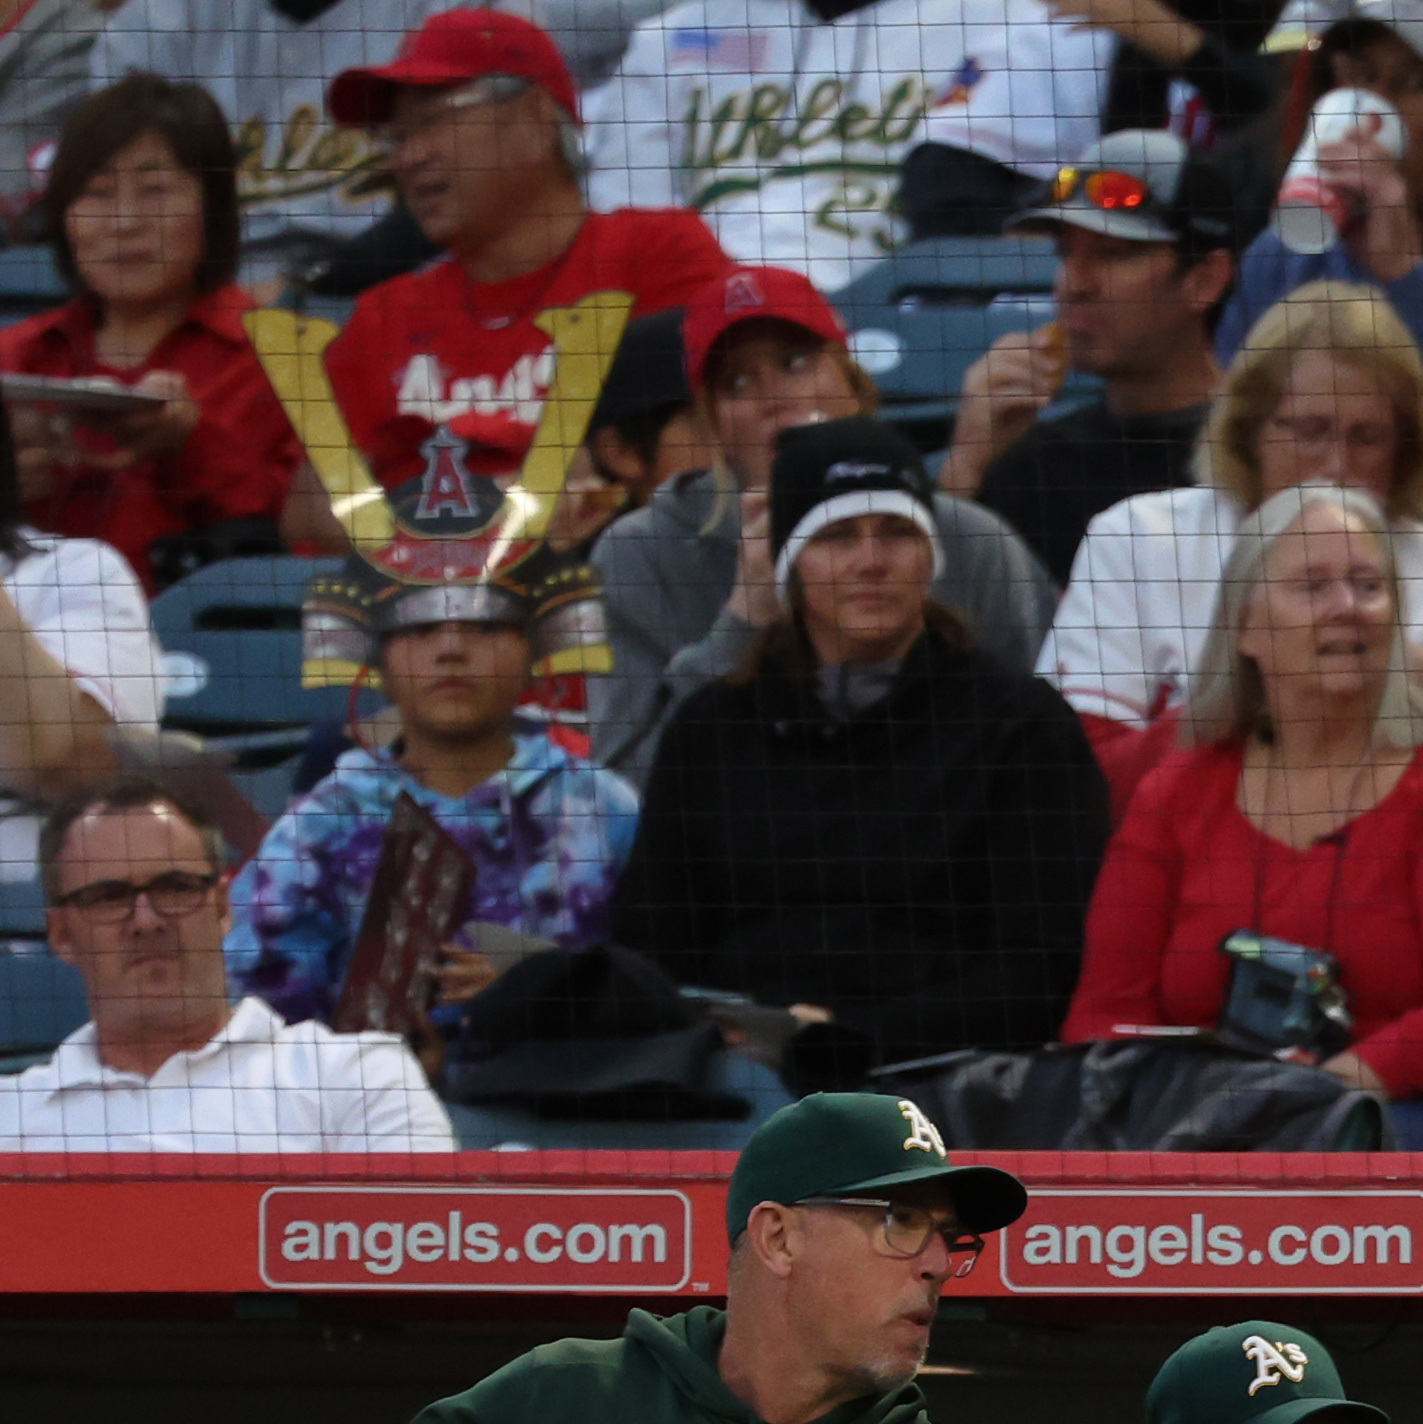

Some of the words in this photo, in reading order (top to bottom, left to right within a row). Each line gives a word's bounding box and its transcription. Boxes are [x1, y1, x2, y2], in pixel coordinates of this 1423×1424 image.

[281, 1211, 667, 1275] angels.com
[1023, 1213, 1412, 1278] angels.com
[1241, 1335, 1309, 1397] A's
